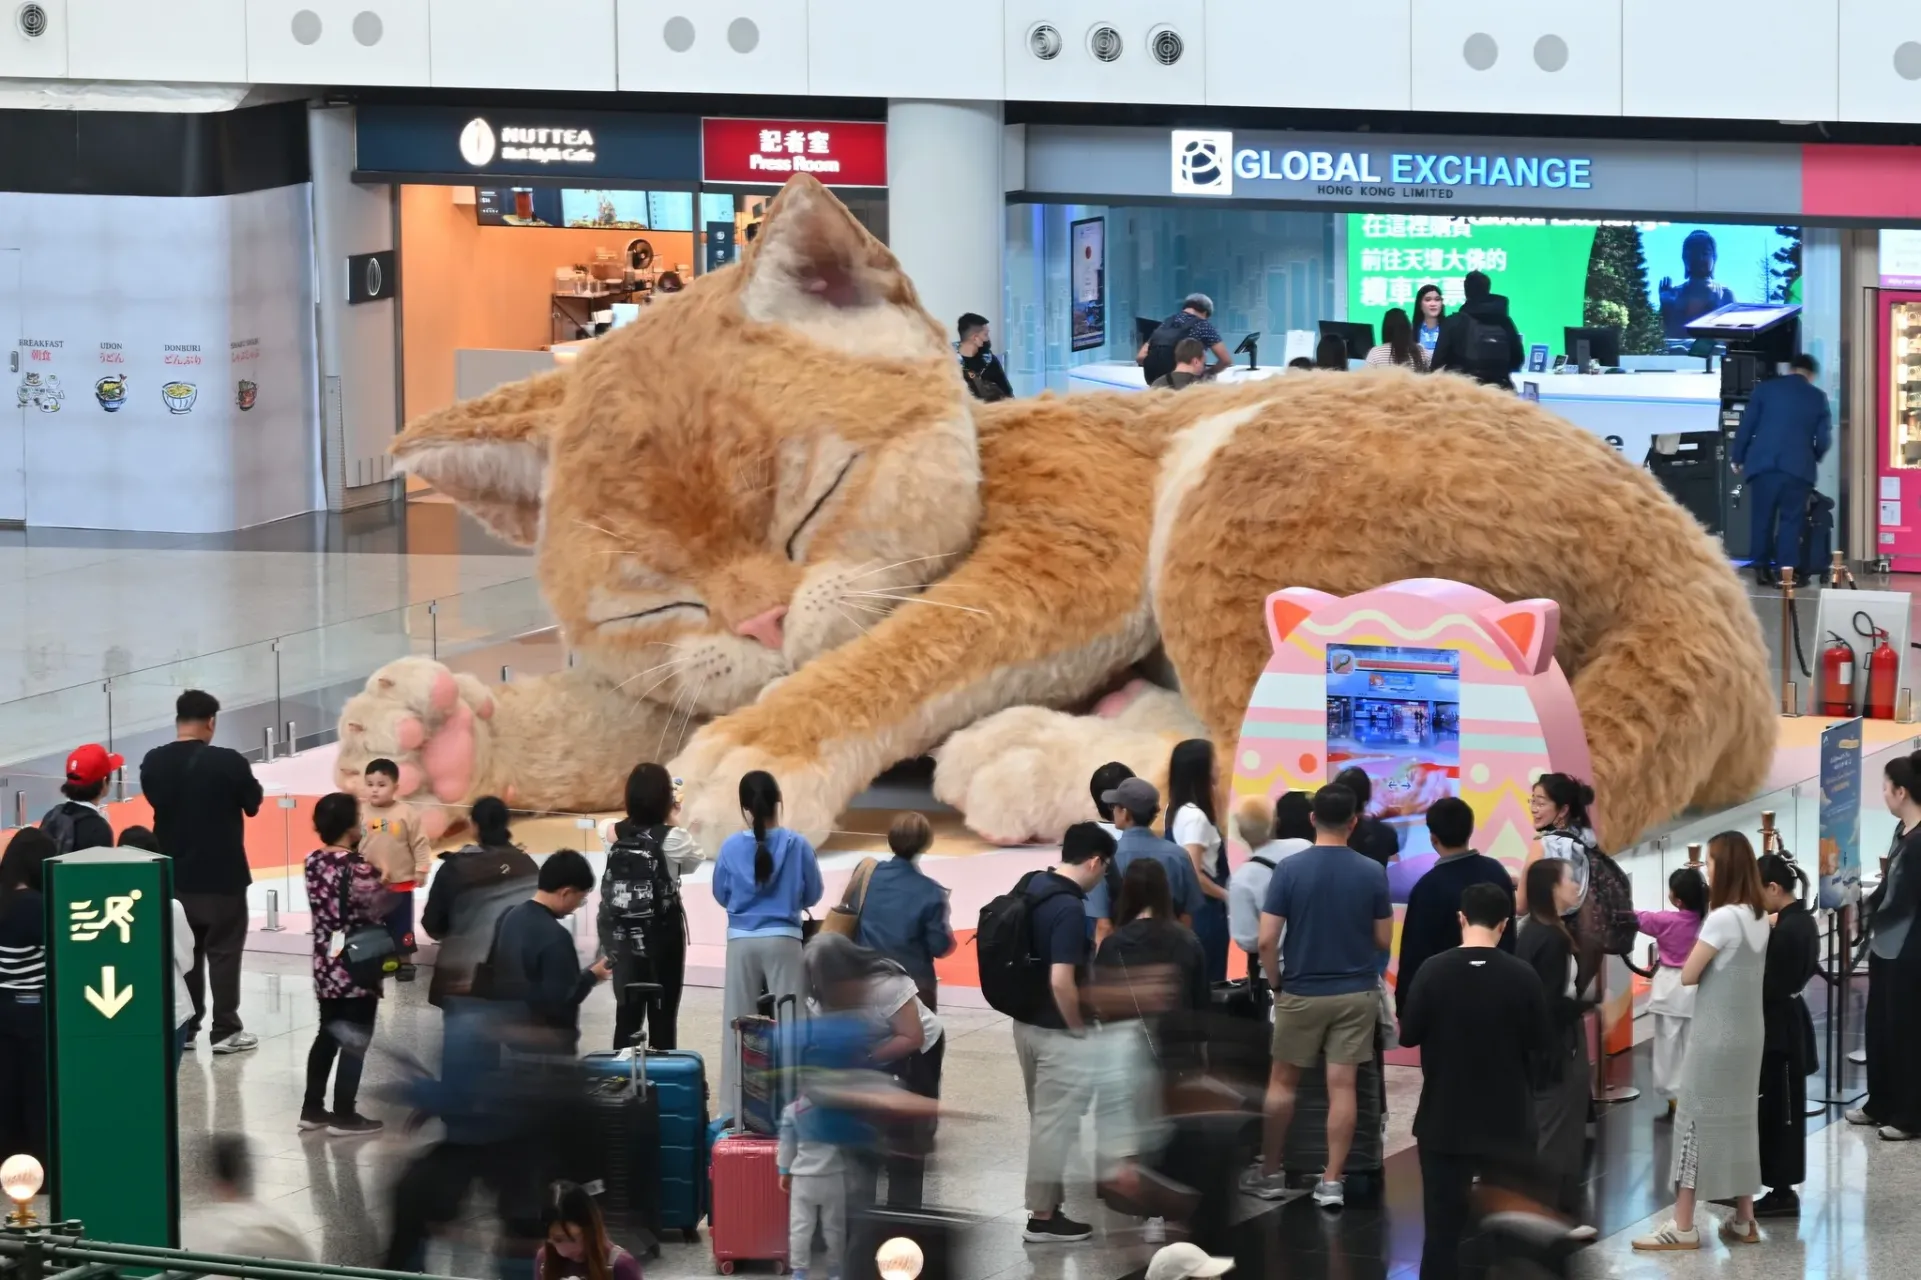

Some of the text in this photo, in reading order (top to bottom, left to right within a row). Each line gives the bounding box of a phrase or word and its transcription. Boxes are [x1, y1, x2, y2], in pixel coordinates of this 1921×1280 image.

[501, 127, 593, 145] NUTTEA
[759, 130, 829, 153] 記者室
[750, 154, 839, 172] Press Room
[1234, 149, 1592, 189] GLOBAL EXCHANGE
[1318, 185, 1454, 199] HONG KONG LIMITED
[1360, 248, 1507, 271] 前往天壇大佛的
[19, 338, 64, 348] BREAKFAST
[100, 342, 122, 350] UDON
[164, 344, 201, 352] DONBURI
[30, 350, 52, 361] 朝食
[100, 352, 125, 363] うどん
[164, 354, 201, 366] どんぶり
